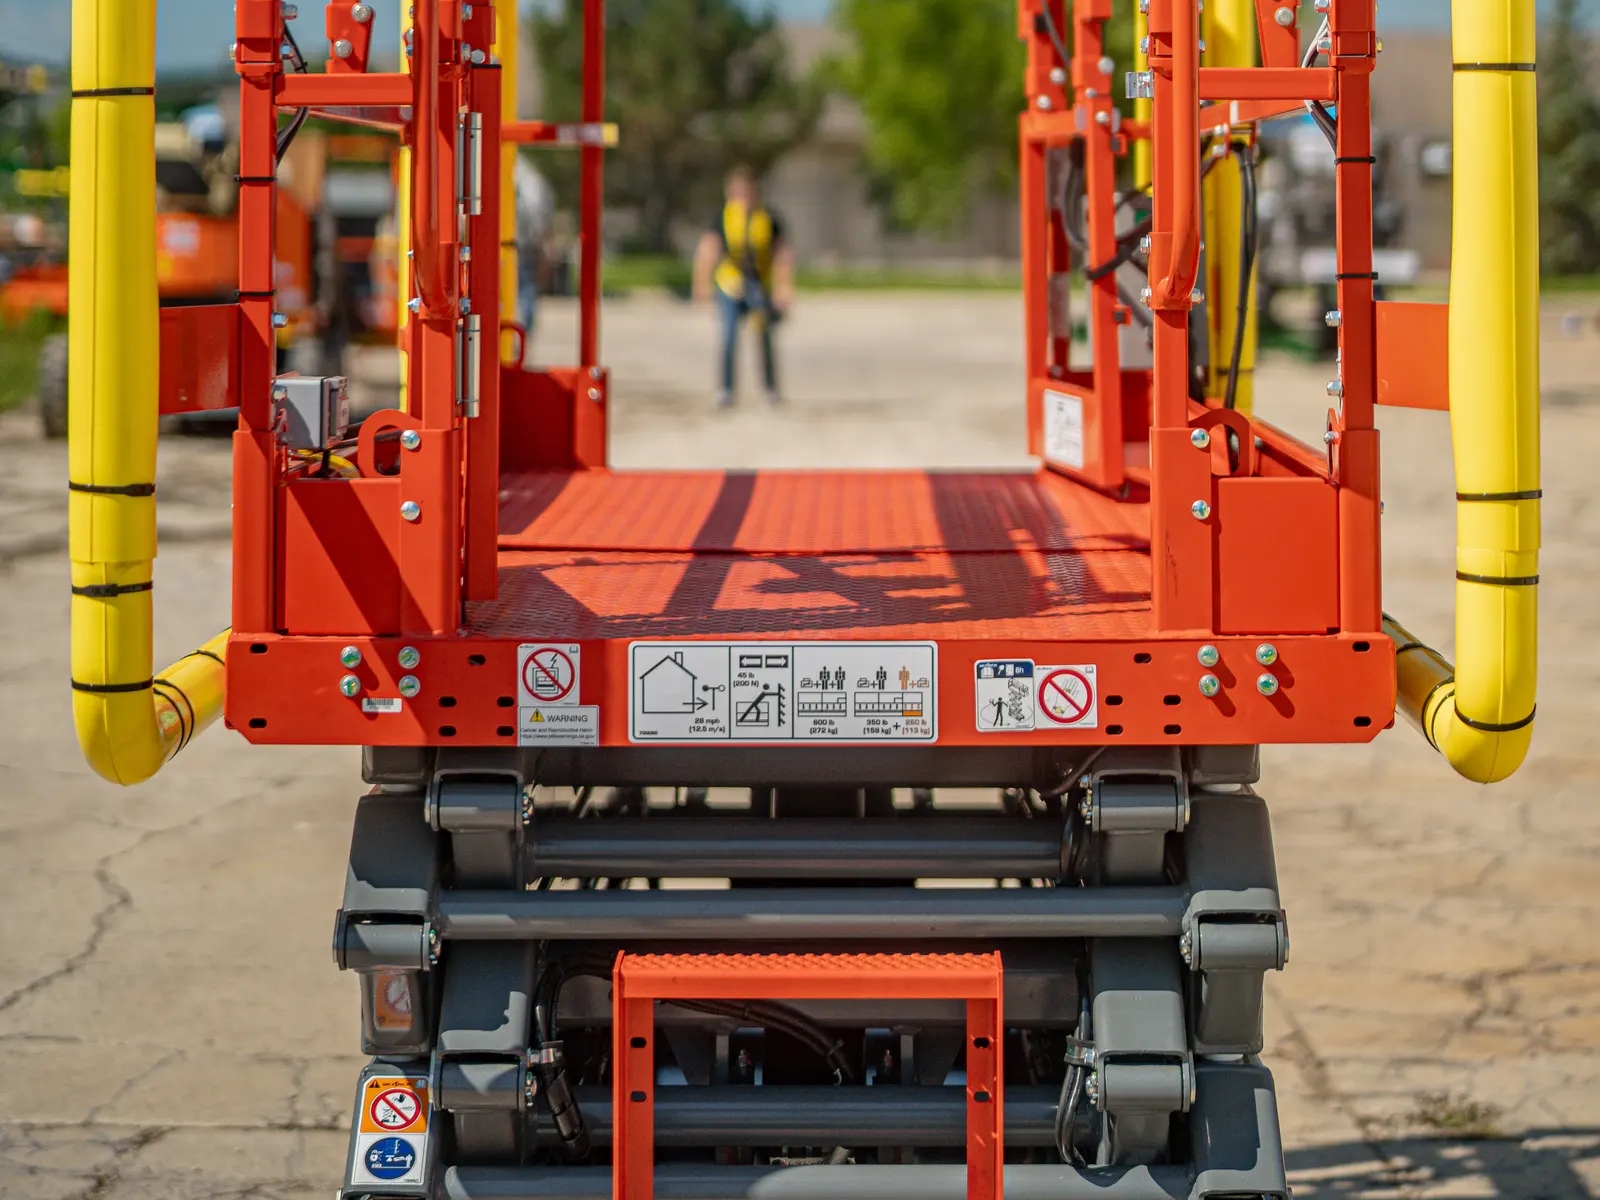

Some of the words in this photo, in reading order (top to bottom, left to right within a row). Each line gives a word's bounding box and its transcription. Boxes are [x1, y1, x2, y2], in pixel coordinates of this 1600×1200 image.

[1015, 666, 1024, 674] 8h
[733, 680, 750, 688] (200
[750, 680, 760, 688] N)
[547, 714, 588, 722] WARNING
[705, 717, 720, 725] mph
[809, 727, 826, 735] (272
[827, 727, 838, 735] kg)
[880, 727, 891, 735] kg)
[919, 727, 930, 735] kg)
